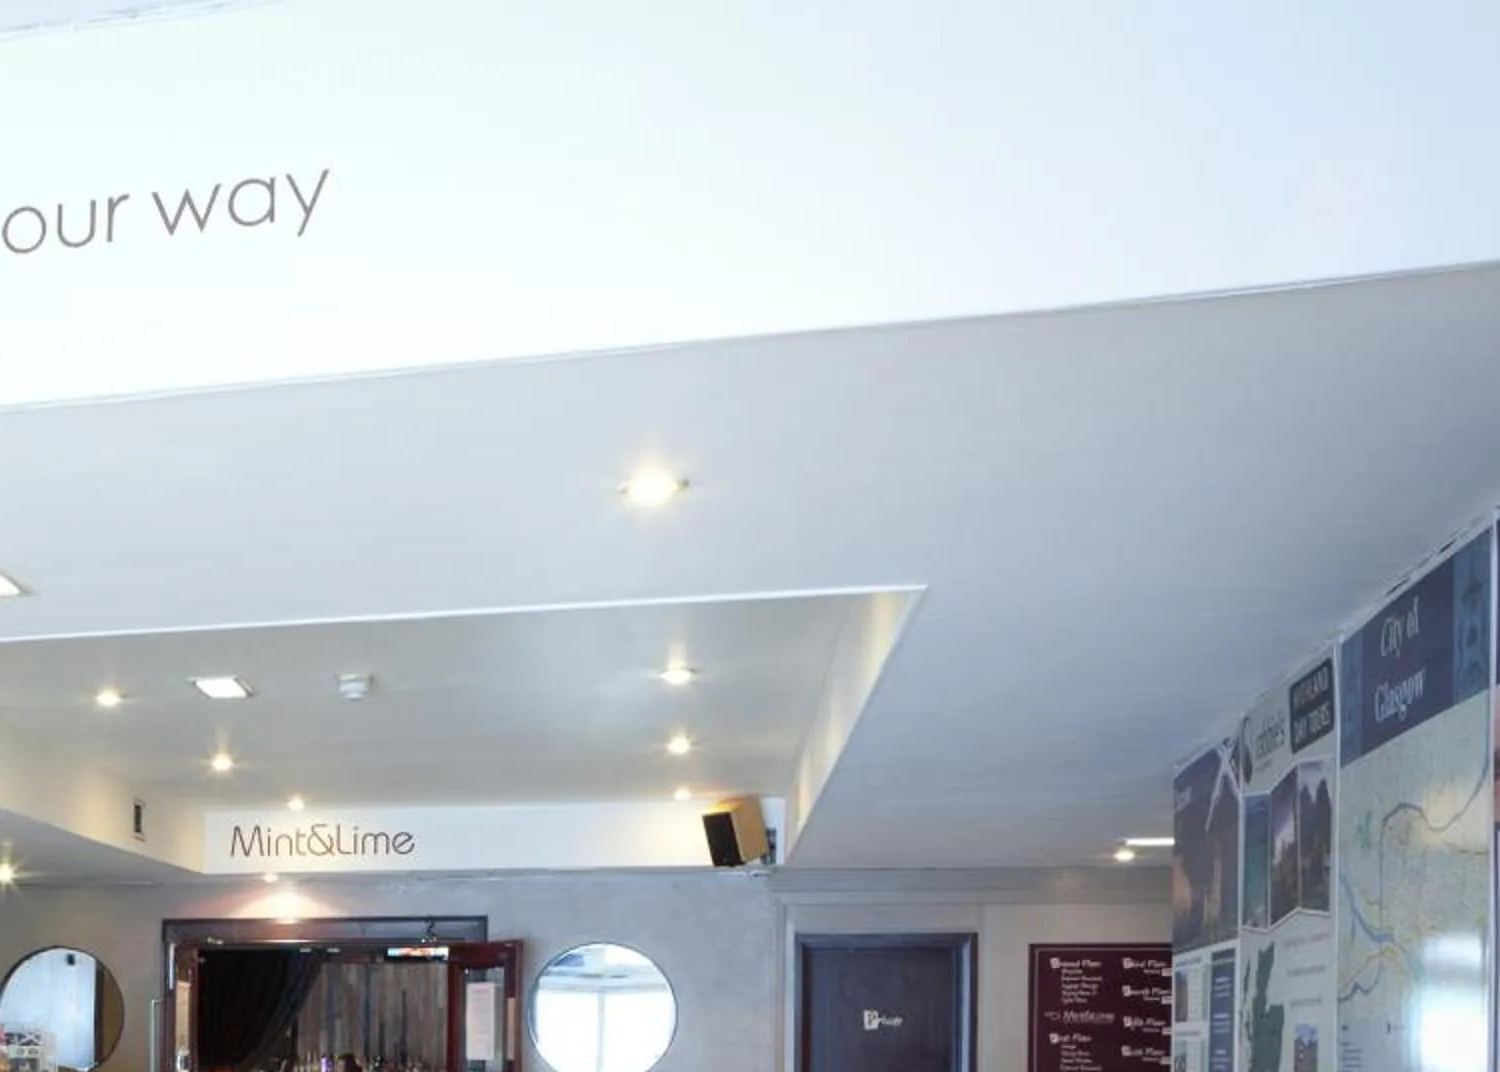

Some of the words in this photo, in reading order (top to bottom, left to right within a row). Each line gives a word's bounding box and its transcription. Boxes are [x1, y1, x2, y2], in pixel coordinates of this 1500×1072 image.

[151, 168, 331, 238] way
[1374, 668, 1426, 722] Glasgow
[230, 823, 415, 858] Mint&Lime
